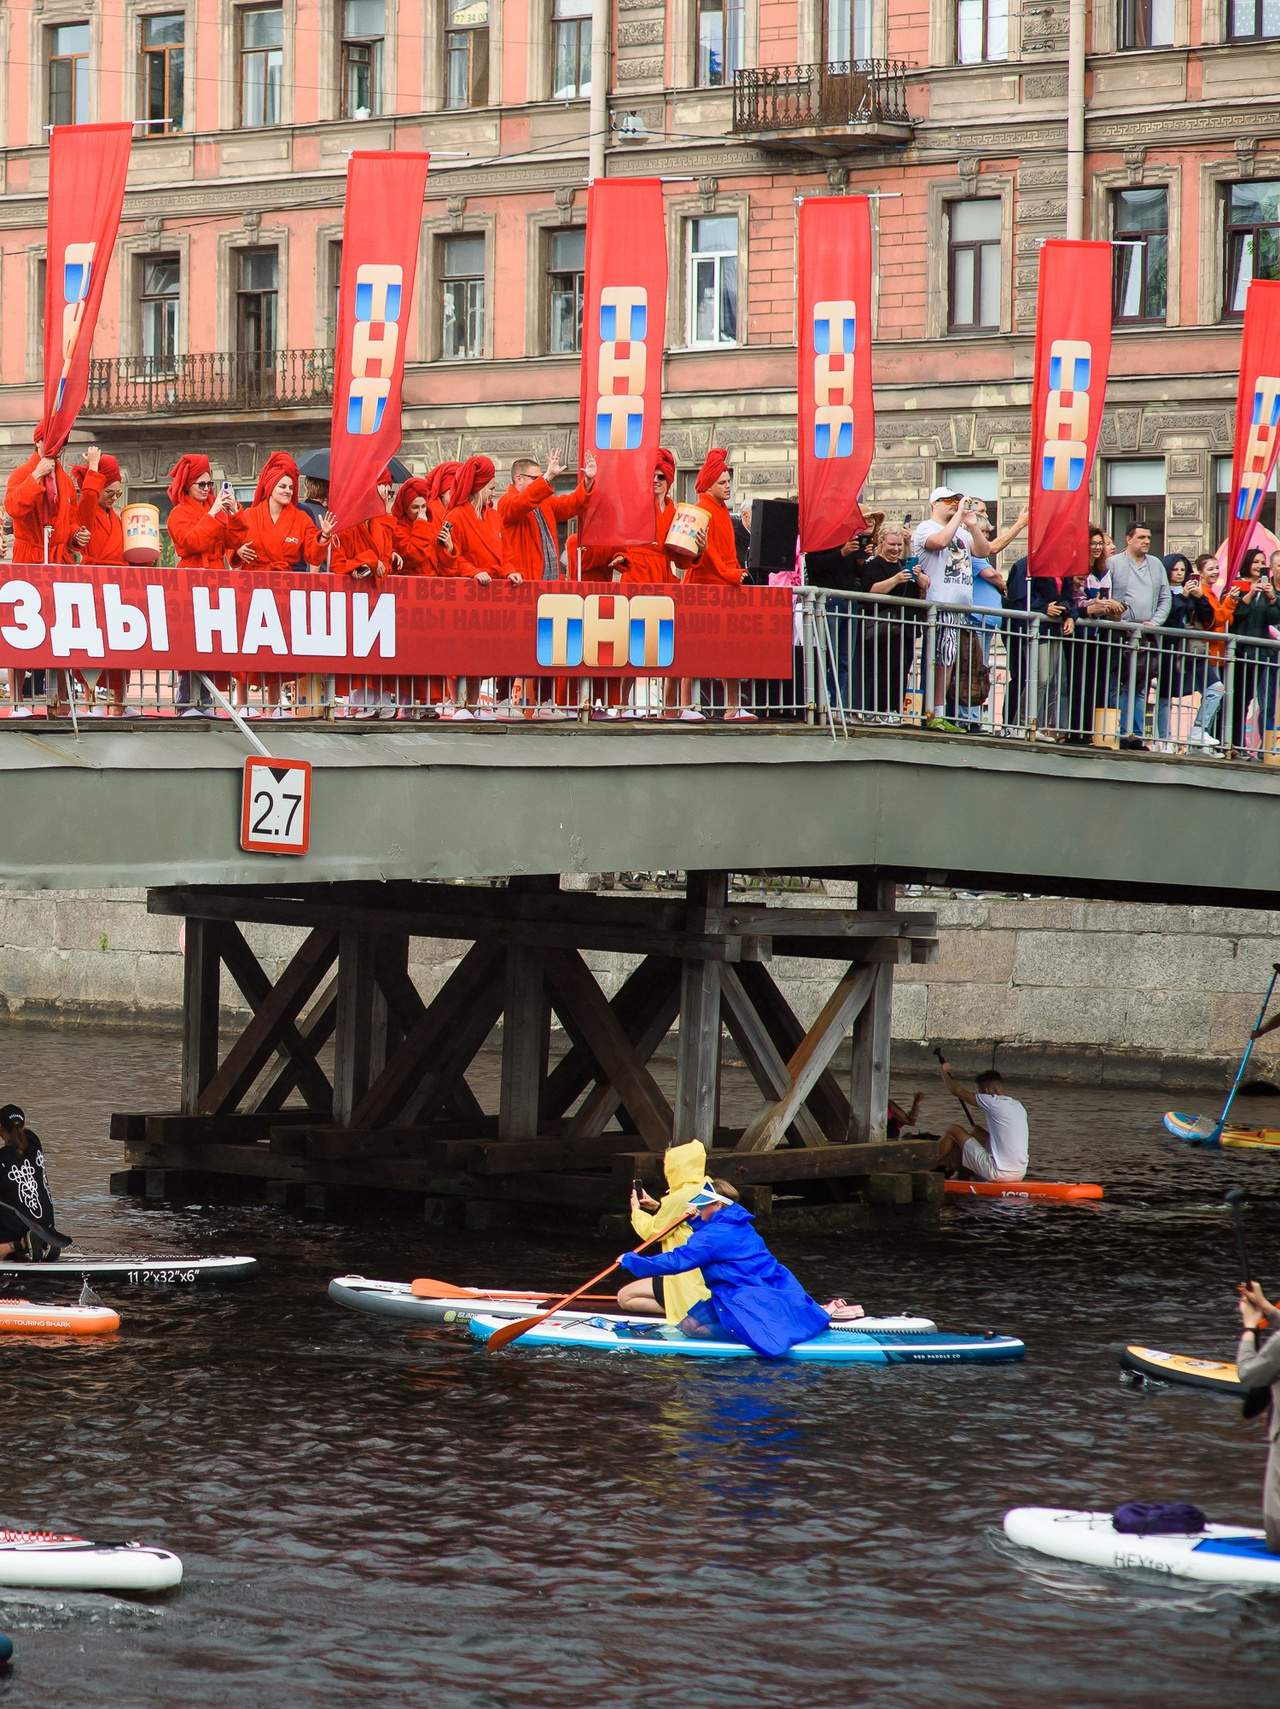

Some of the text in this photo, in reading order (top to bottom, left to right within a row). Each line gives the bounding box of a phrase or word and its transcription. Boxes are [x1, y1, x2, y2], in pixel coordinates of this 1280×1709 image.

[346, 264, 403, 434] ТНТ
[595, 286, 647, 450] ТНТ
[813, 300, 856, 459] ТНТ
[1041, 340, 1092, 491] ТНТ
[1236, 376, 1280, 520] ТНТ
[192, 586, 397, 658] НАШИ
[415, 578, 457, 601] ВСЕ
[537, 594, 675, 667] ТНТ
[252, 791, 302, 836] 2.7
[13, 1319, 45, 1327] TOURING
[45, 1320, 71, 1328] SHARK
